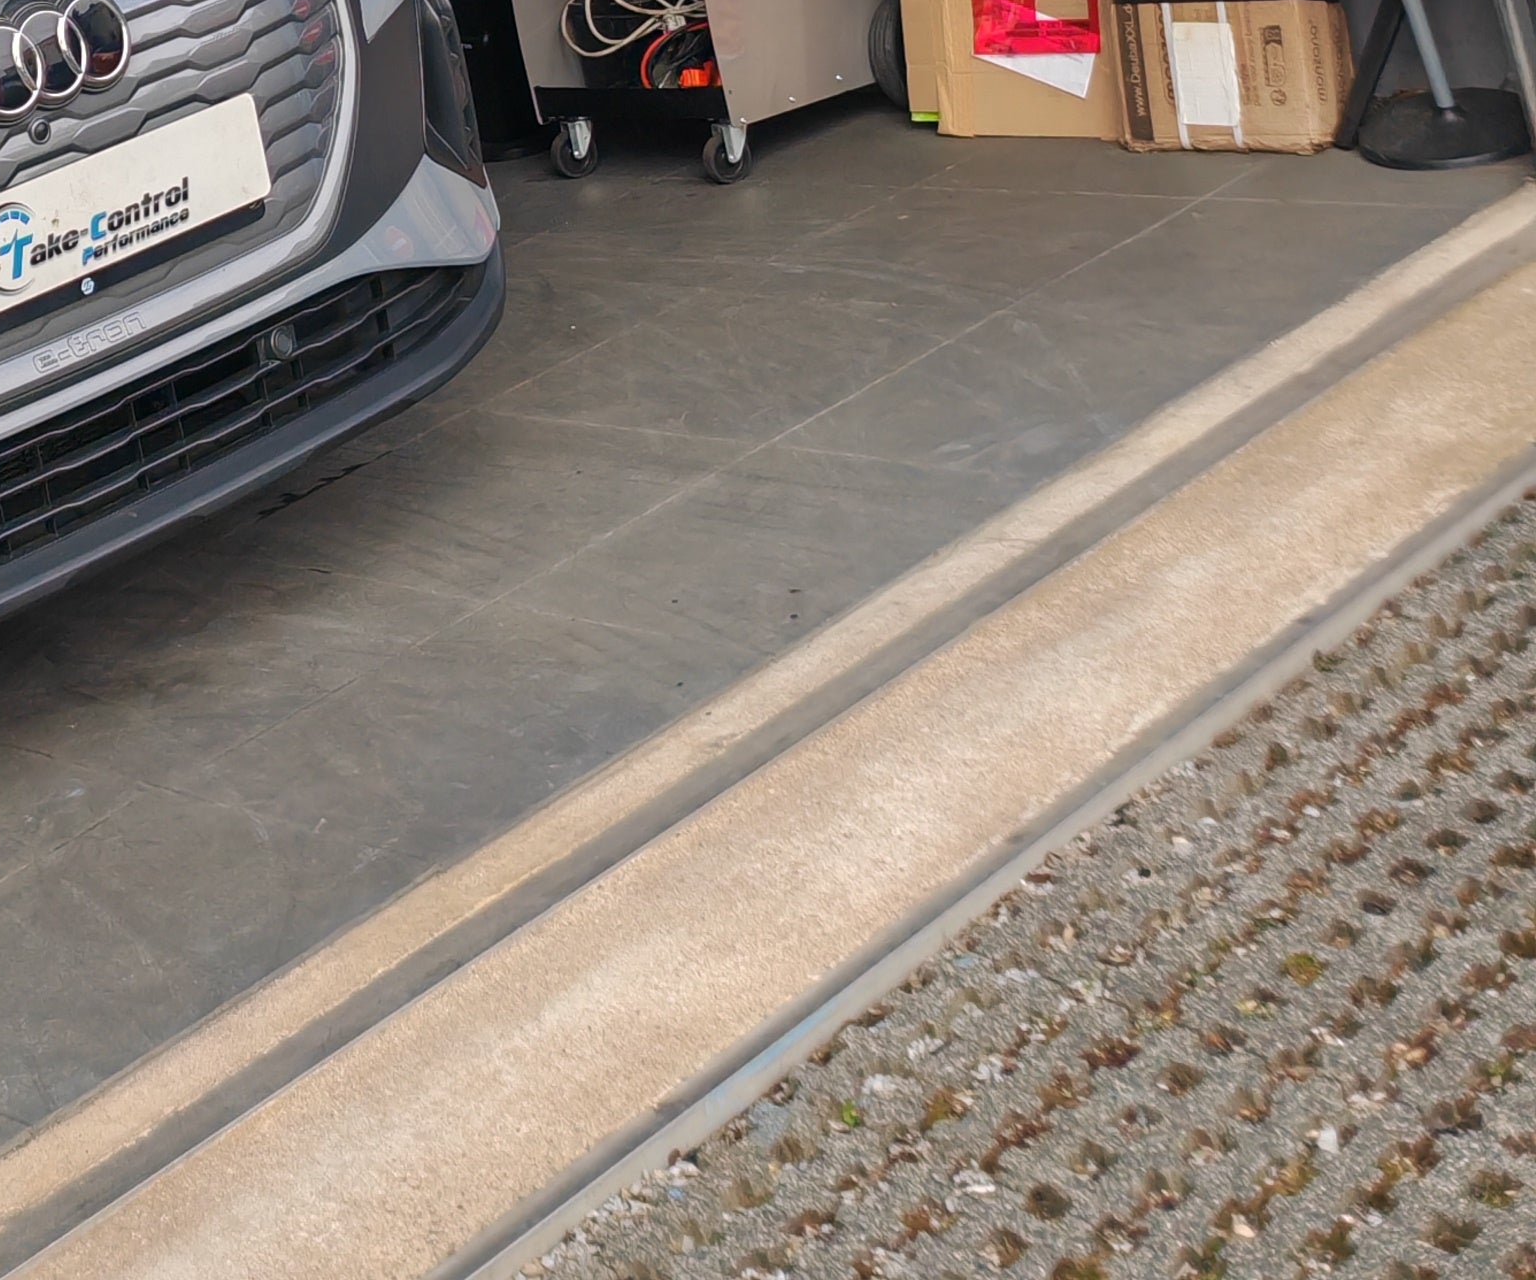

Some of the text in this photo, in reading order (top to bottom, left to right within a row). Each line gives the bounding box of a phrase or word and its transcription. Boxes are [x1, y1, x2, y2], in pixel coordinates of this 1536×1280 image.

[1123, 3, 1146, 117] www.DeubaXXL.d
[82, 207, 189, 267] Performance
[33, 311, 147, 374] e-tron
